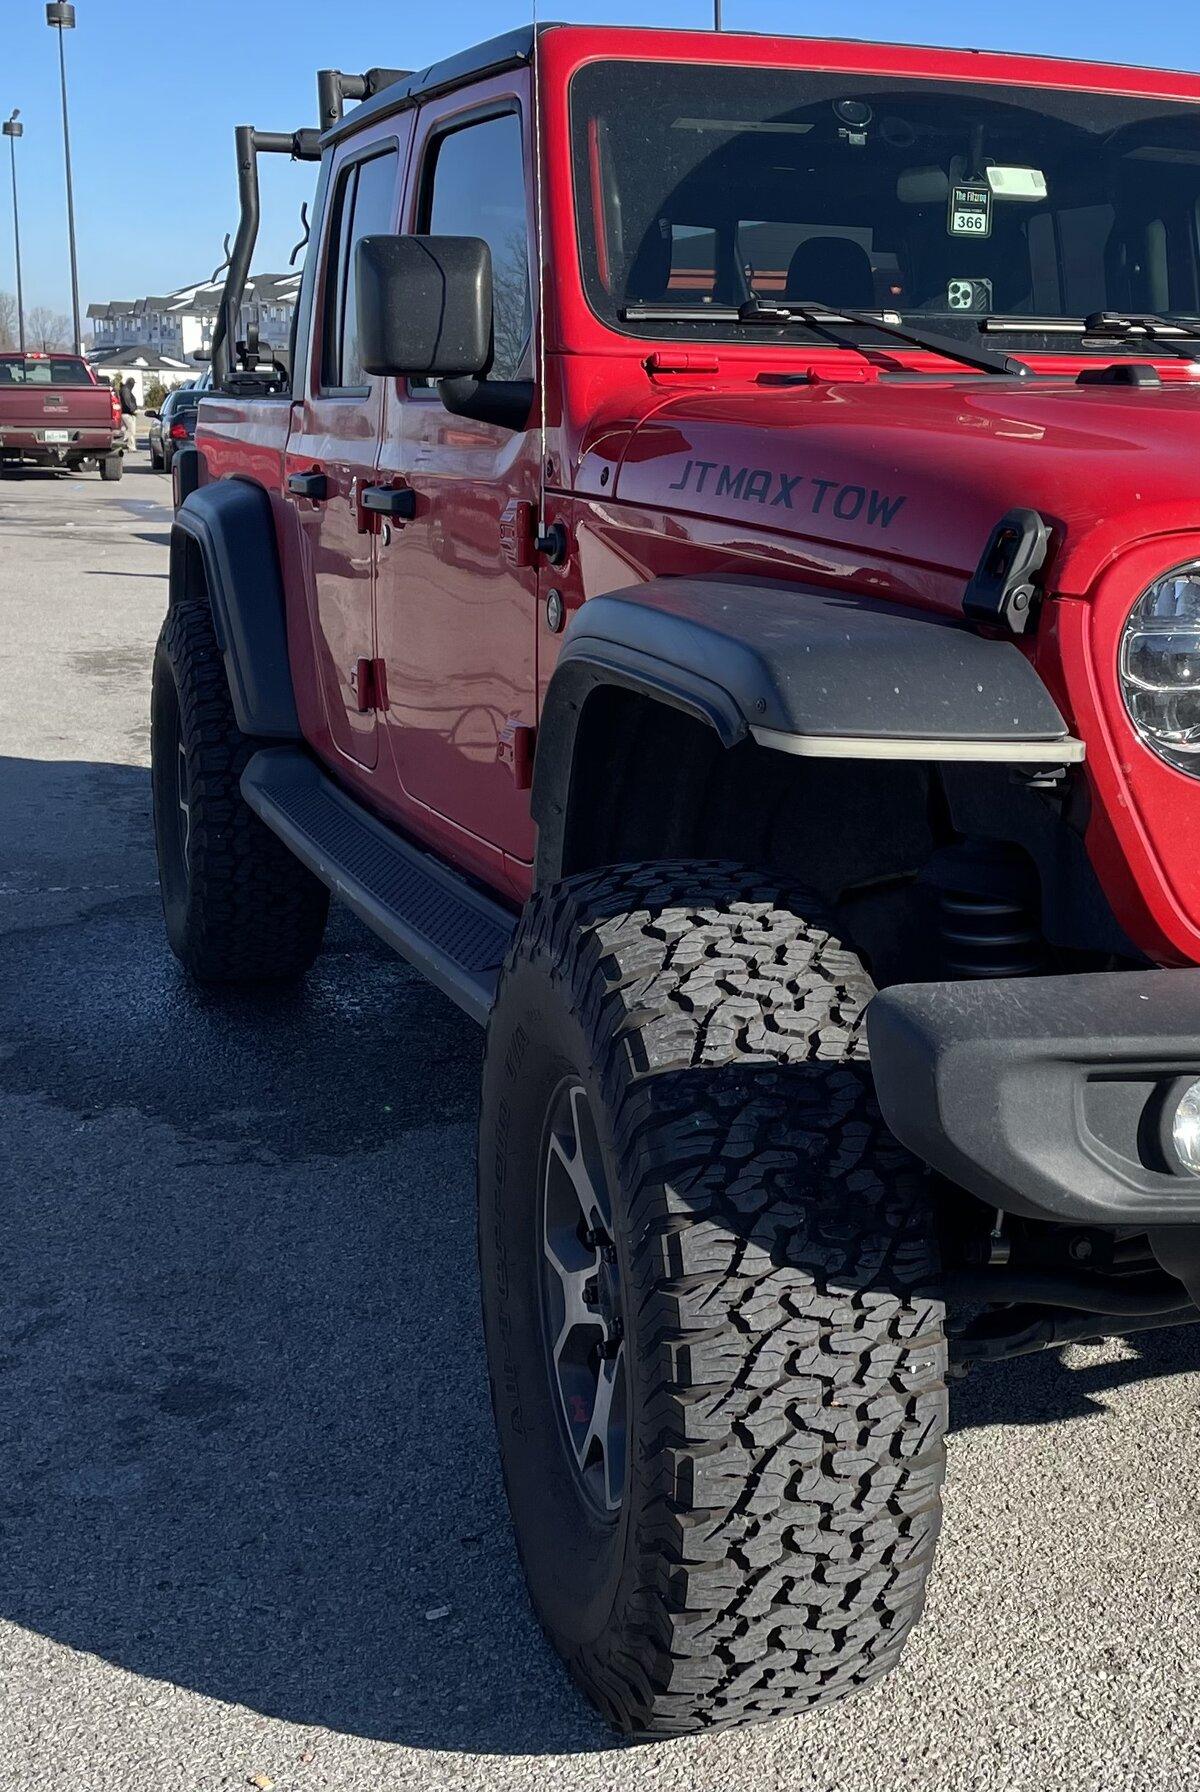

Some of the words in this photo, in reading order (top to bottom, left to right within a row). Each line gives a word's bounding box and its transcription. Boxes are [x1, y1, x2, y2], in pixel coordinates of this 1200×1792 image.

[956, 190, 966, 201] The
[958, 216, 982, 229] 366
[811, 478, 908, 529] TOW
